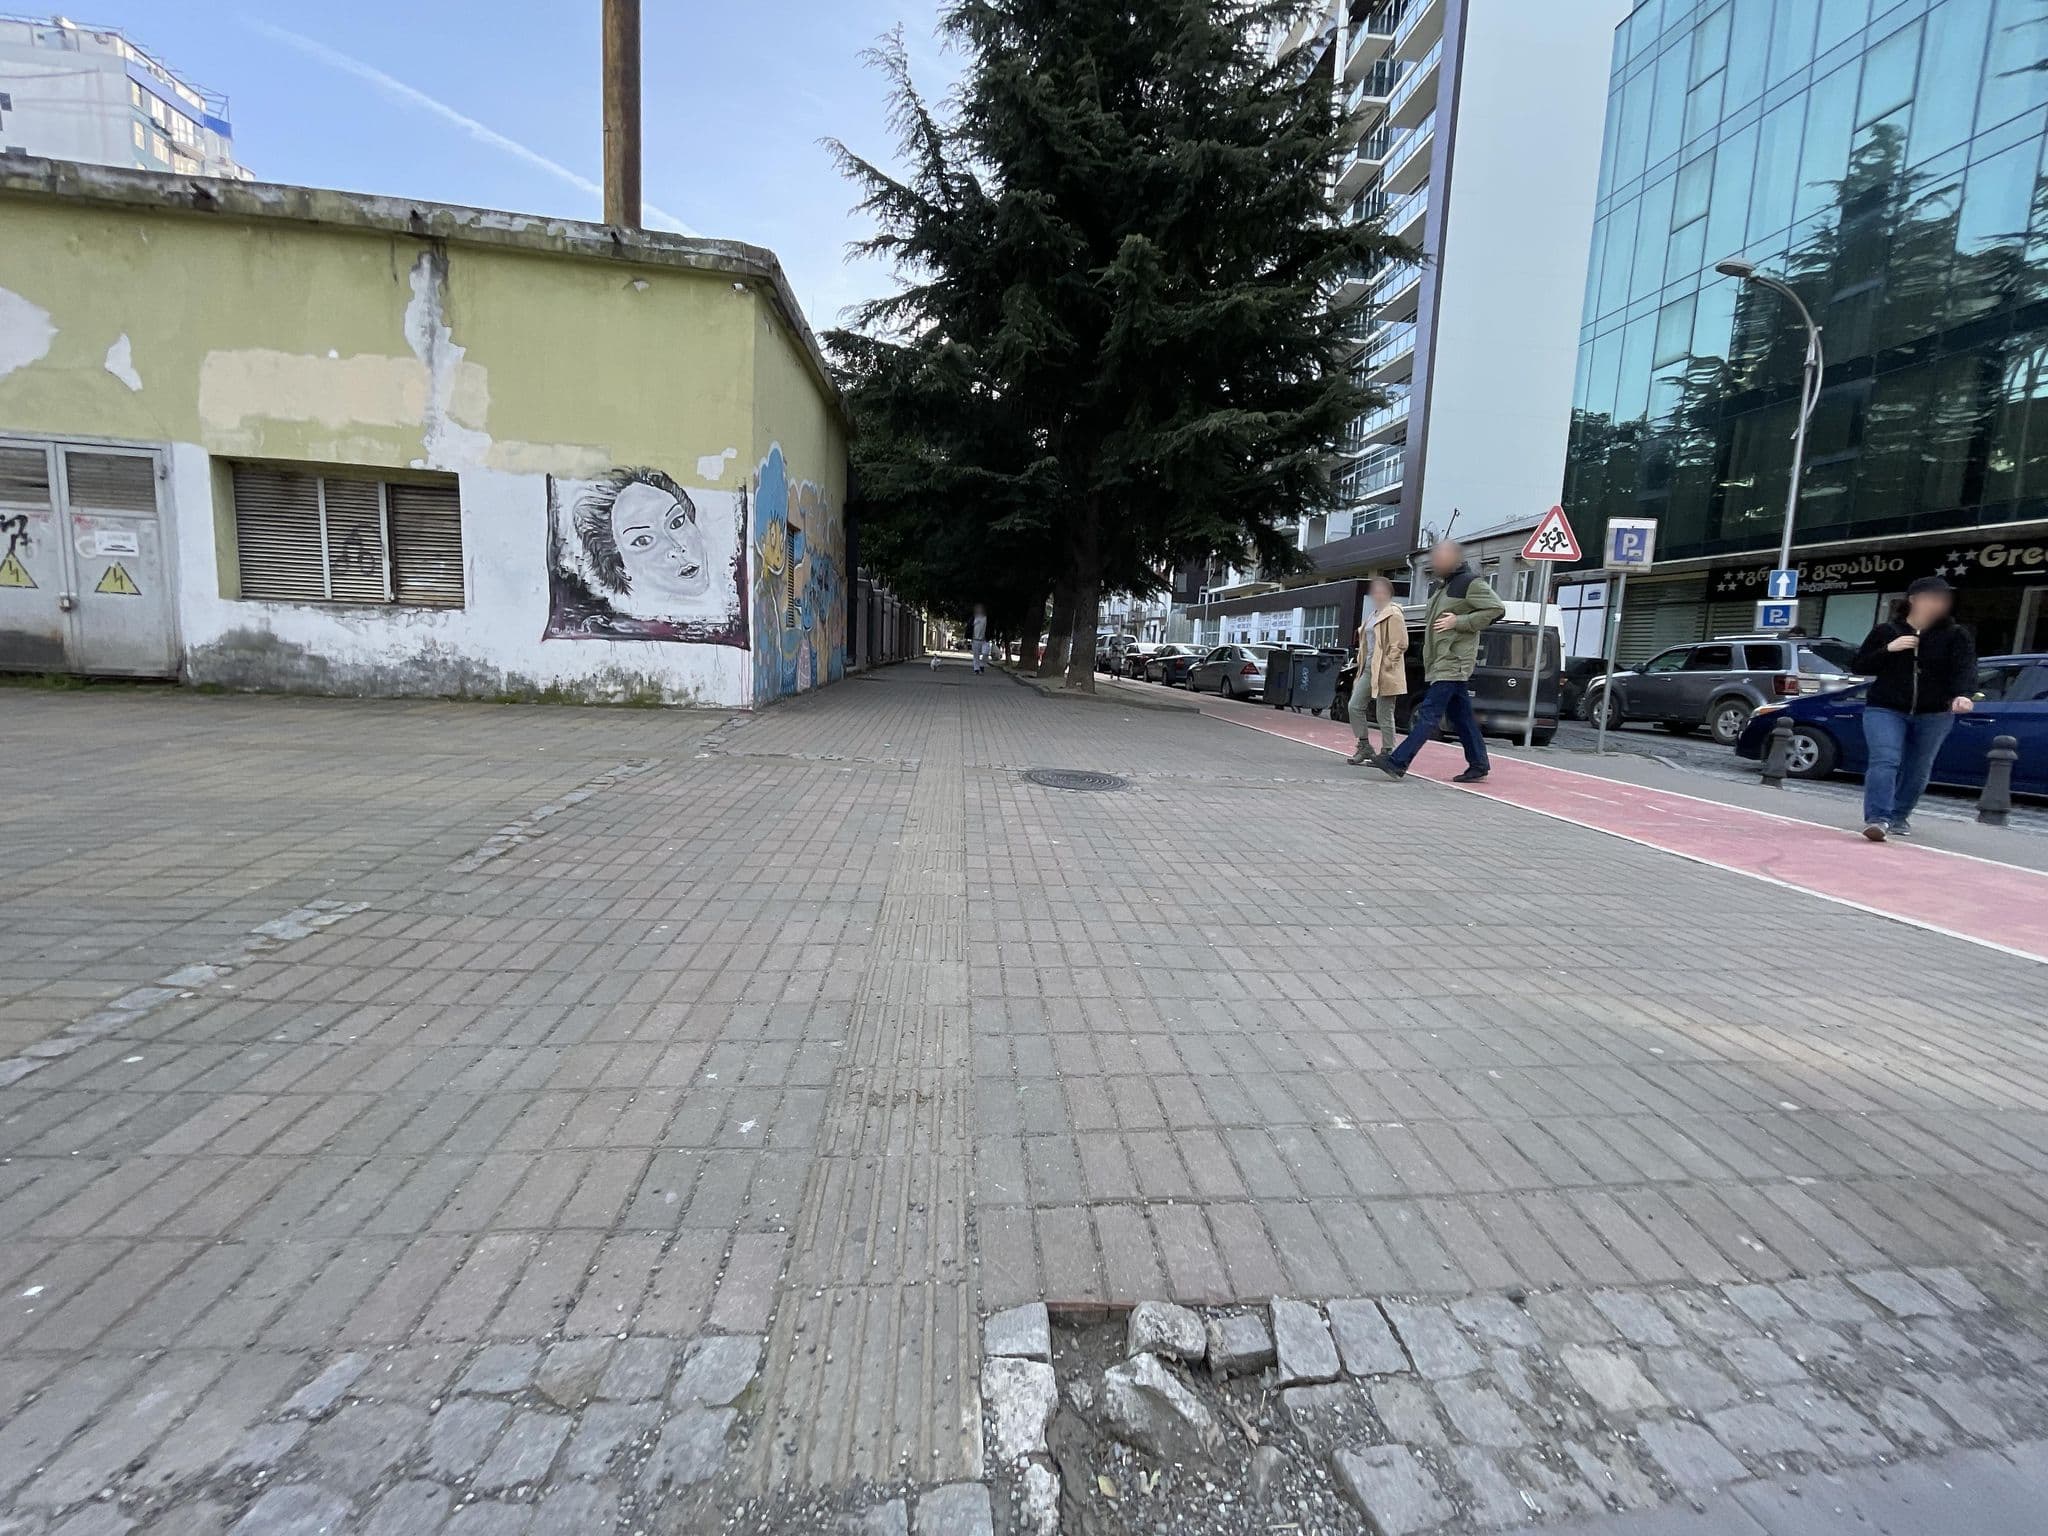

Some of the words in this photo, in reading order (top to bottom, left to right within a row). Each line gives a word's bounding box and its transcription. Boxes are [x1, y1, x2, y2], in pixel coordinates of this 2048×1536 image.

[1622, 533, 1639, 556] P
[1980, 543, 2048, 568] Gre
[1744, 562, 1808, 586] გრნ
[1769, 609, 1783, 623] P
